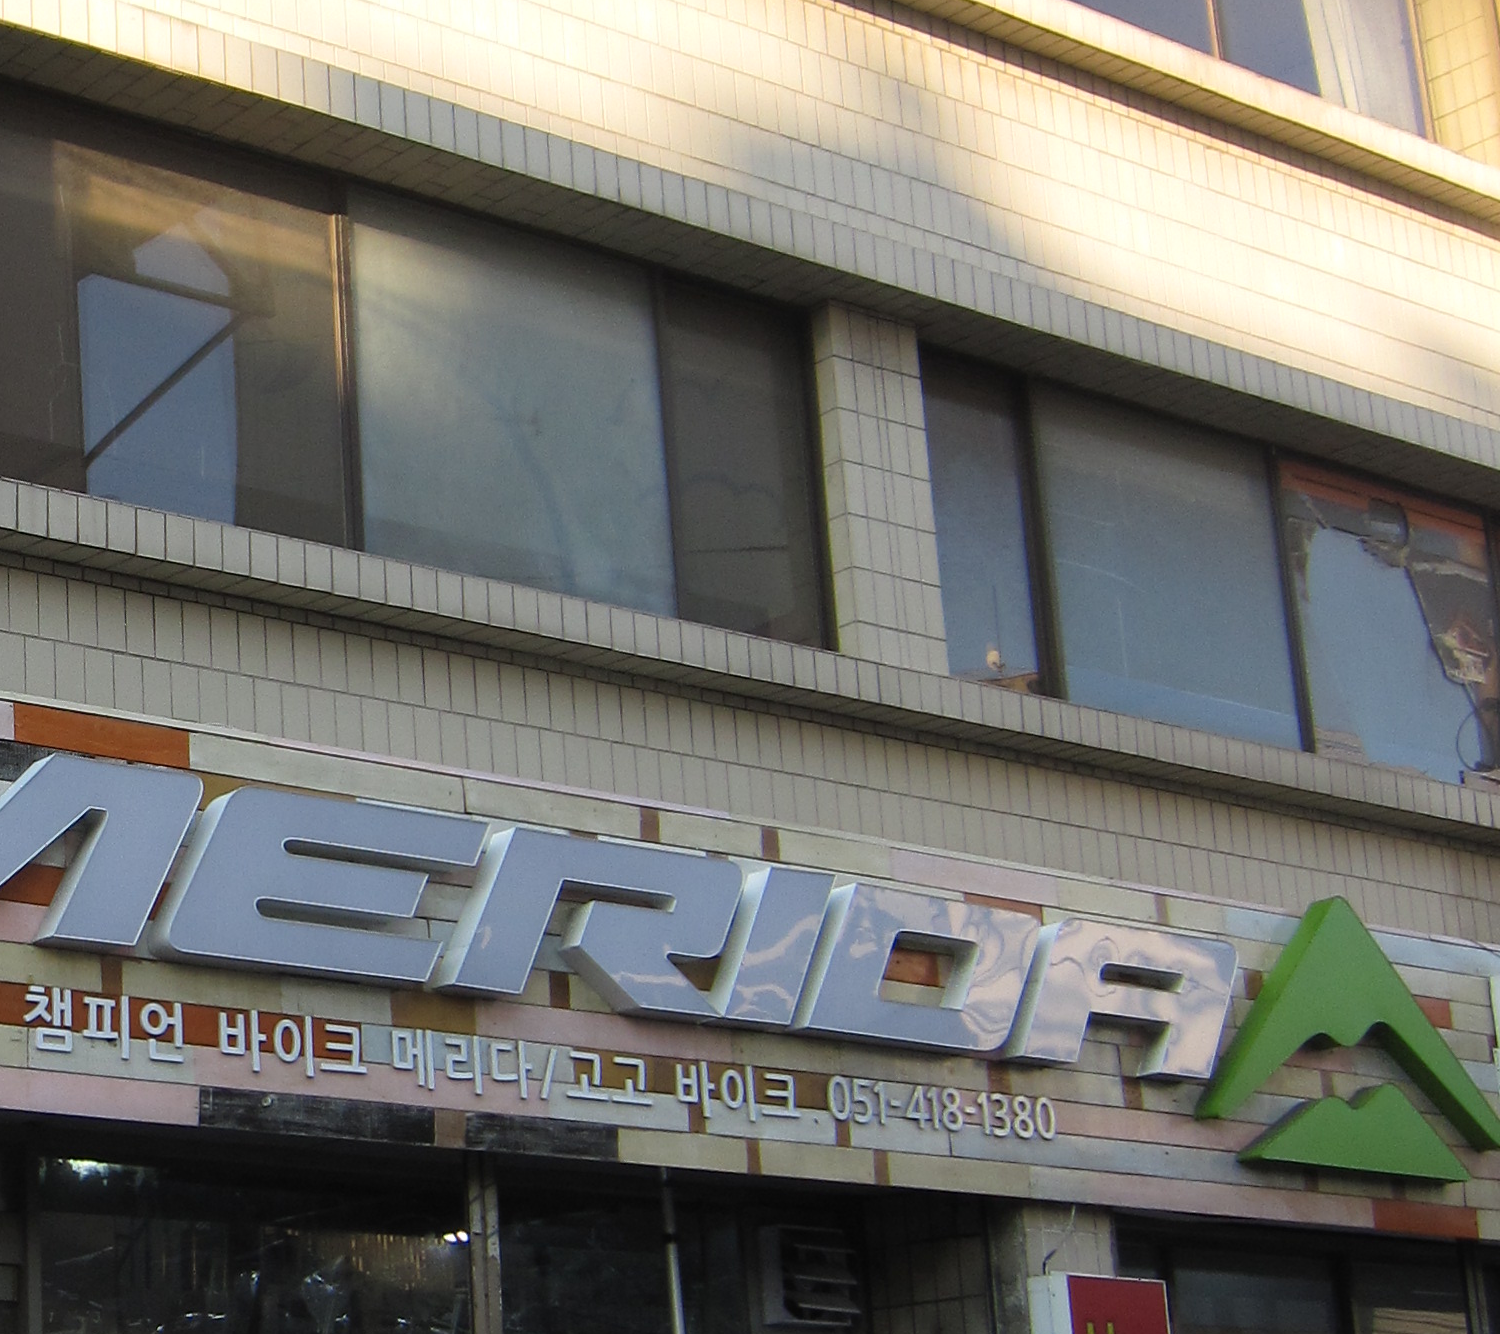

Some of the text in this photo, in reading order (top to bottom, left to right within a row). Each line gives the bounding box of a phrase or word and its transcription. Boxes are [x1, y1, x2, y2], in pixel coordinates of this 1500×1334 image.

[23, 983, 186, 1064] 챔피언
[218, 1008, 368, 1080] 바이크
[827, 1076, 1057, 1143] 051-418-1380
